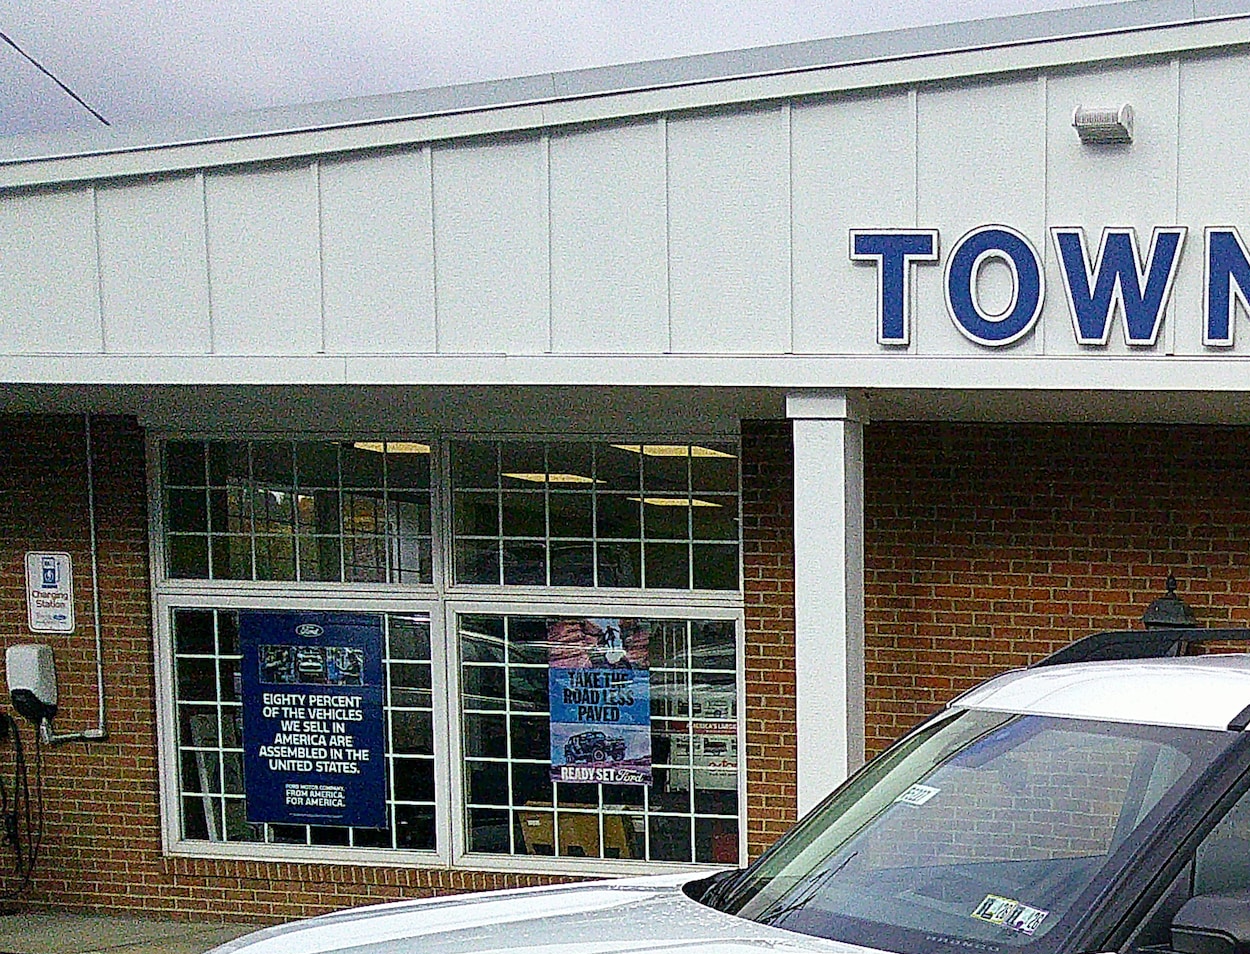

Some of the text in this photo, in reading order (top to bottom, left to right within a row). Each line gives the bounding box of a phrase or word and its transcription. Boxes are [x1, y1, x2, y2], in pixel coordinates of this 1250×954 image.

[32, 590, 68, 600] Charging
[36, 599, 66, 608] Station
[567, 671, 629, 689] TAKE THE
[262, 693, 363, 708] EIGHTY PERCENT
[563, 688, 634, 706] ROAD LESS
[262, 706, 364, 721] OF THE VEHICLES
[578, 706, 620, 722] PAVED
[281, 720, 346, 733] WE SELL IN
[274, 733, 353, 747] AMERICA ARE
[258, 746, 370, 761] ASSEMBLED IN THE
[268, 759, 361, 774] UNITED STATES.
[561, 766, 644, 783] READY SET Ford
[285, 790, 346, 799] FROM AMERICA.
[286, 797, 346, 808] FOR AMERICA.
